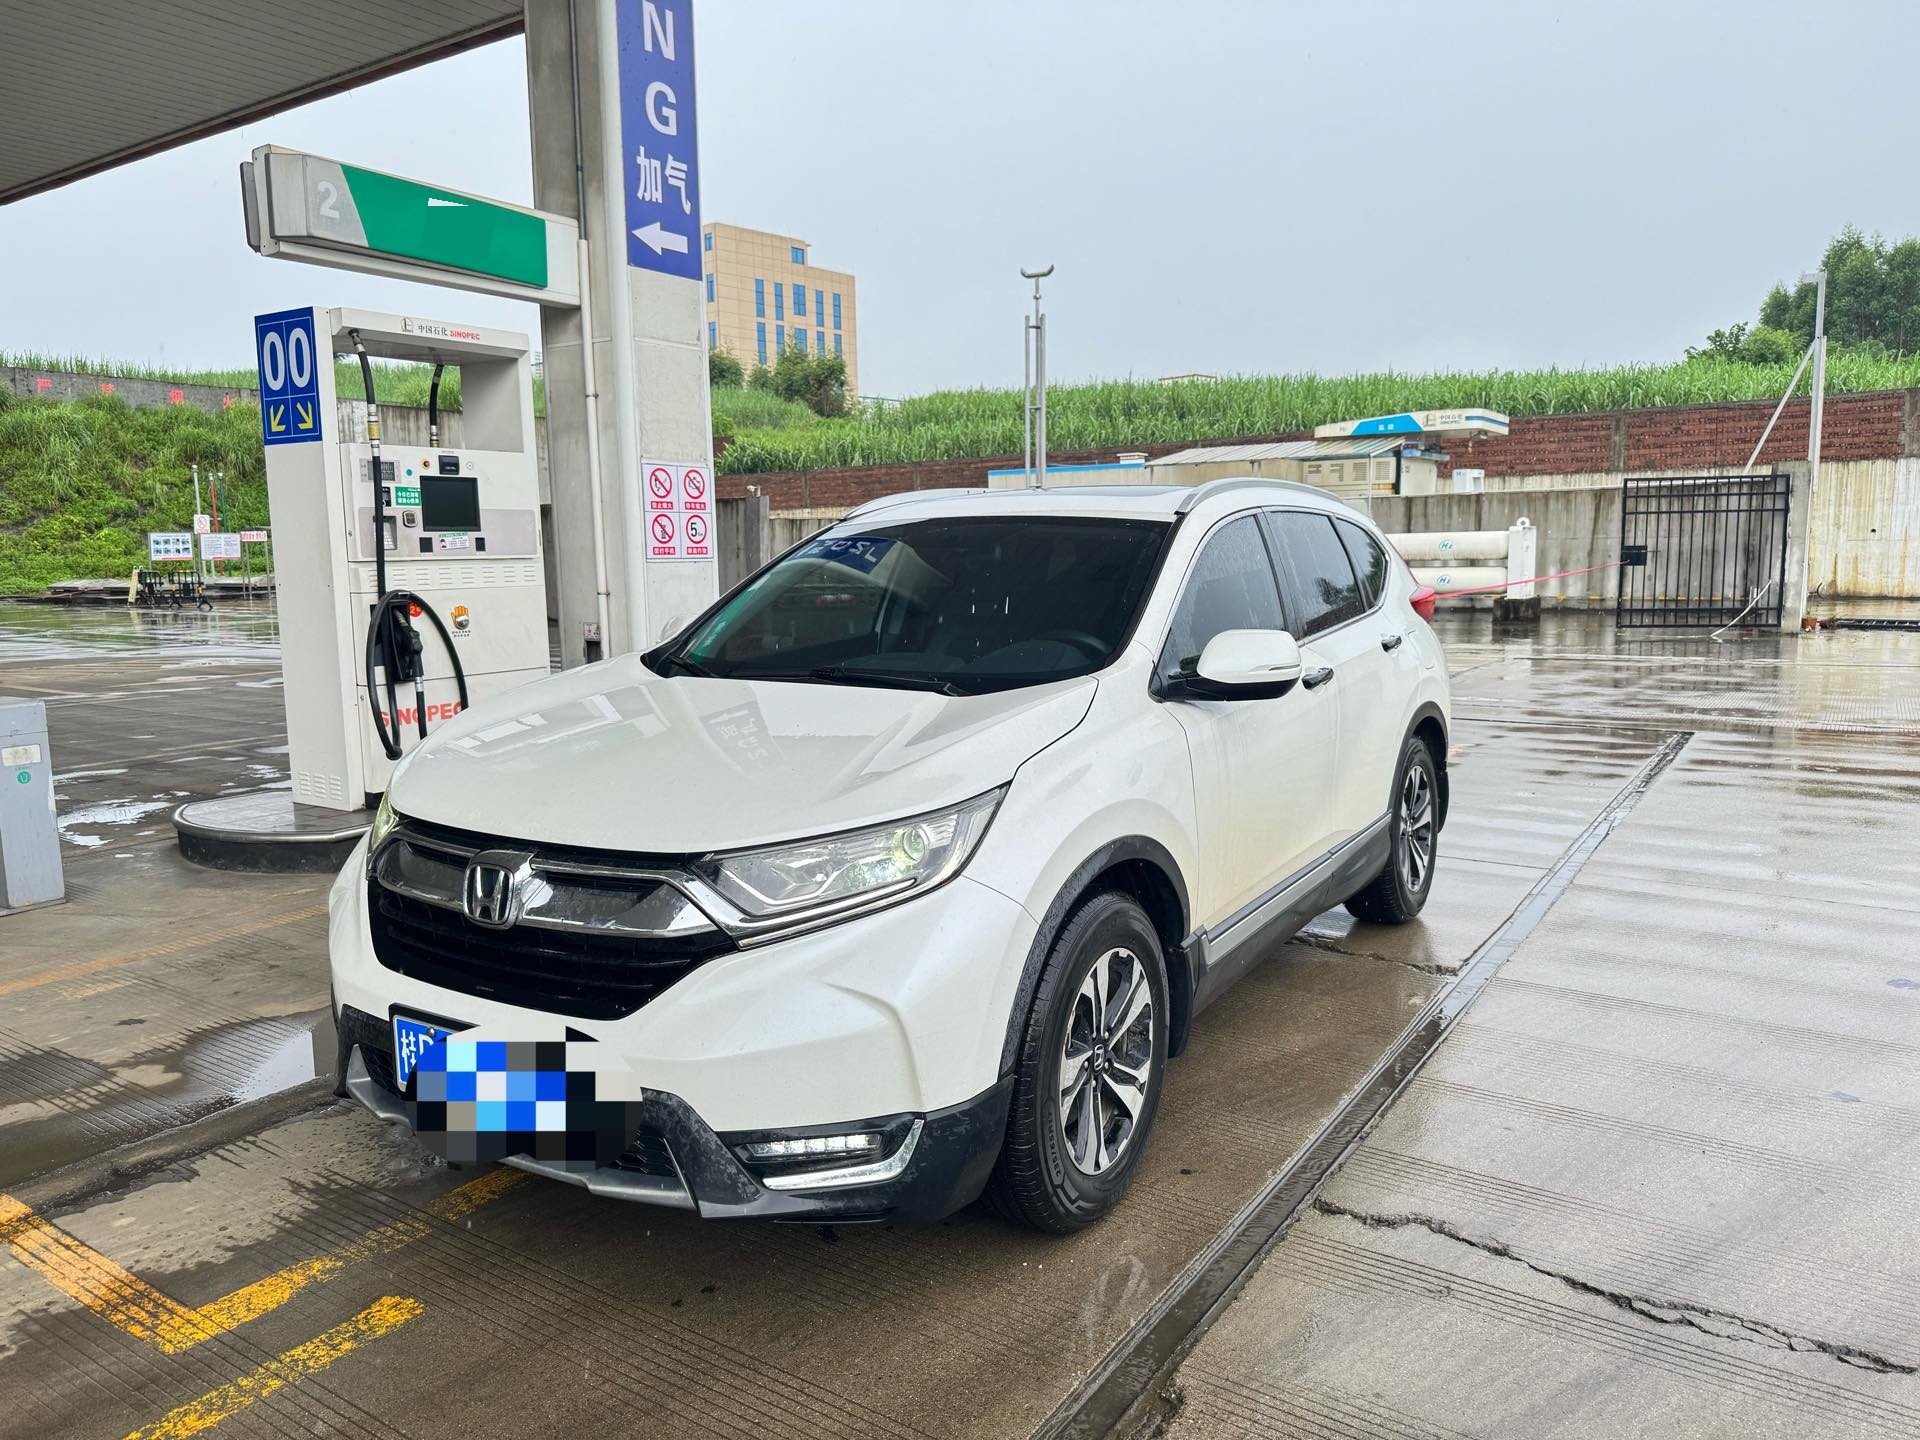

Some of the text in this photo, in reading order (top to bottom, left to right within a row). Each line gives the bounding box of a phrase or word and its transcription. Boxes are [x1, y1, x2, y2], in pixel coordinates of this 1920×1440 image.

[637, 145, 691, 215] 加气
[319, 181, 340, 219] 2
[418, 323, 481, 340] 中国石化 SINOPEC
[690, 522, 698, 538] 5
